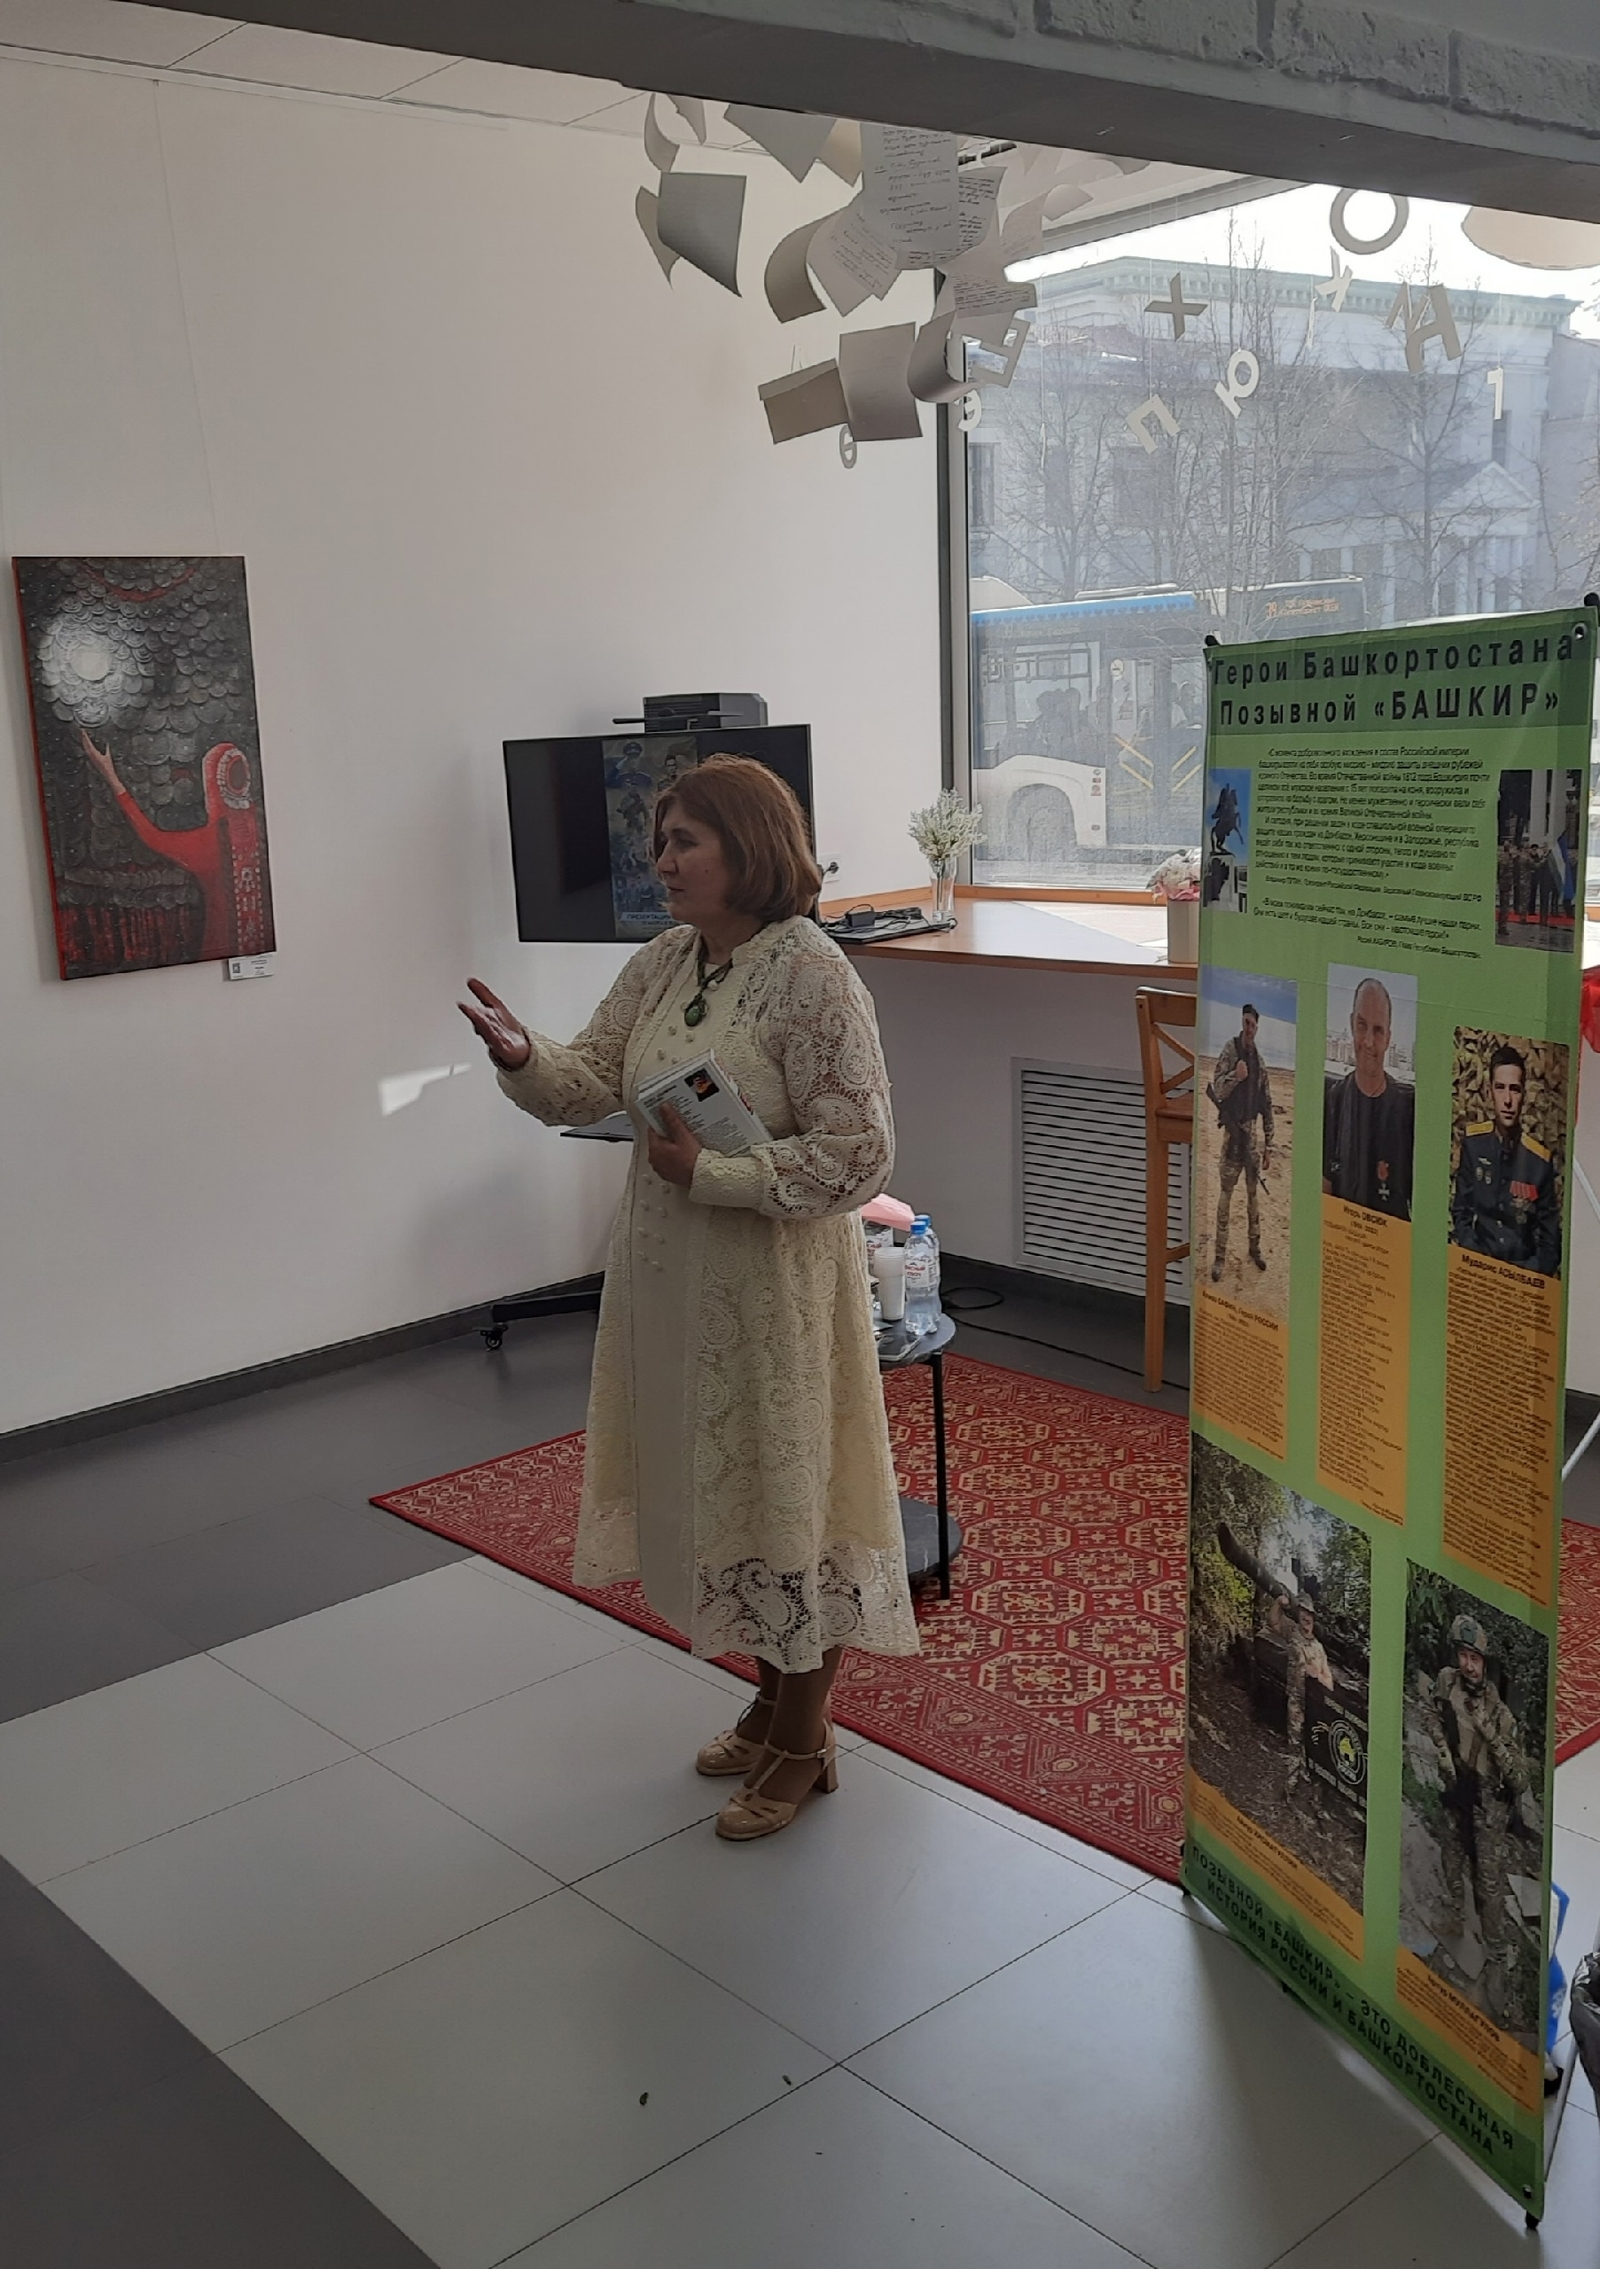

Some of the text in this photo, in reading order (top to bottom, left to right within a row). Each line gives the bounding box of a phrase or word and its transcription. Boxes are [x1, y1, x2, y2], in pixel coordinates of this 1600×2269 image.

[1214, 634, 1573, 689] Герои Башкортостана
[1220, 683, 1559, 725] Позывной «БАШКИР»
[1193, 1846, 1263, 1919] ПОЗЫВНОЙ
[1360, 1999, 1390, 2035] ЭТО
[1397, 2033, 1513, 2150] ДОБЛЕСТНАЯ
[1207, 1879, 1266, 1941] ИСТОРИЯ
[1270, 1937, 1328, 1998] РОССИИ
[1333, 1993, 1342, 2013] И
[1348, 2010, 1493, 2154] БАШКОРТОСТАНА
